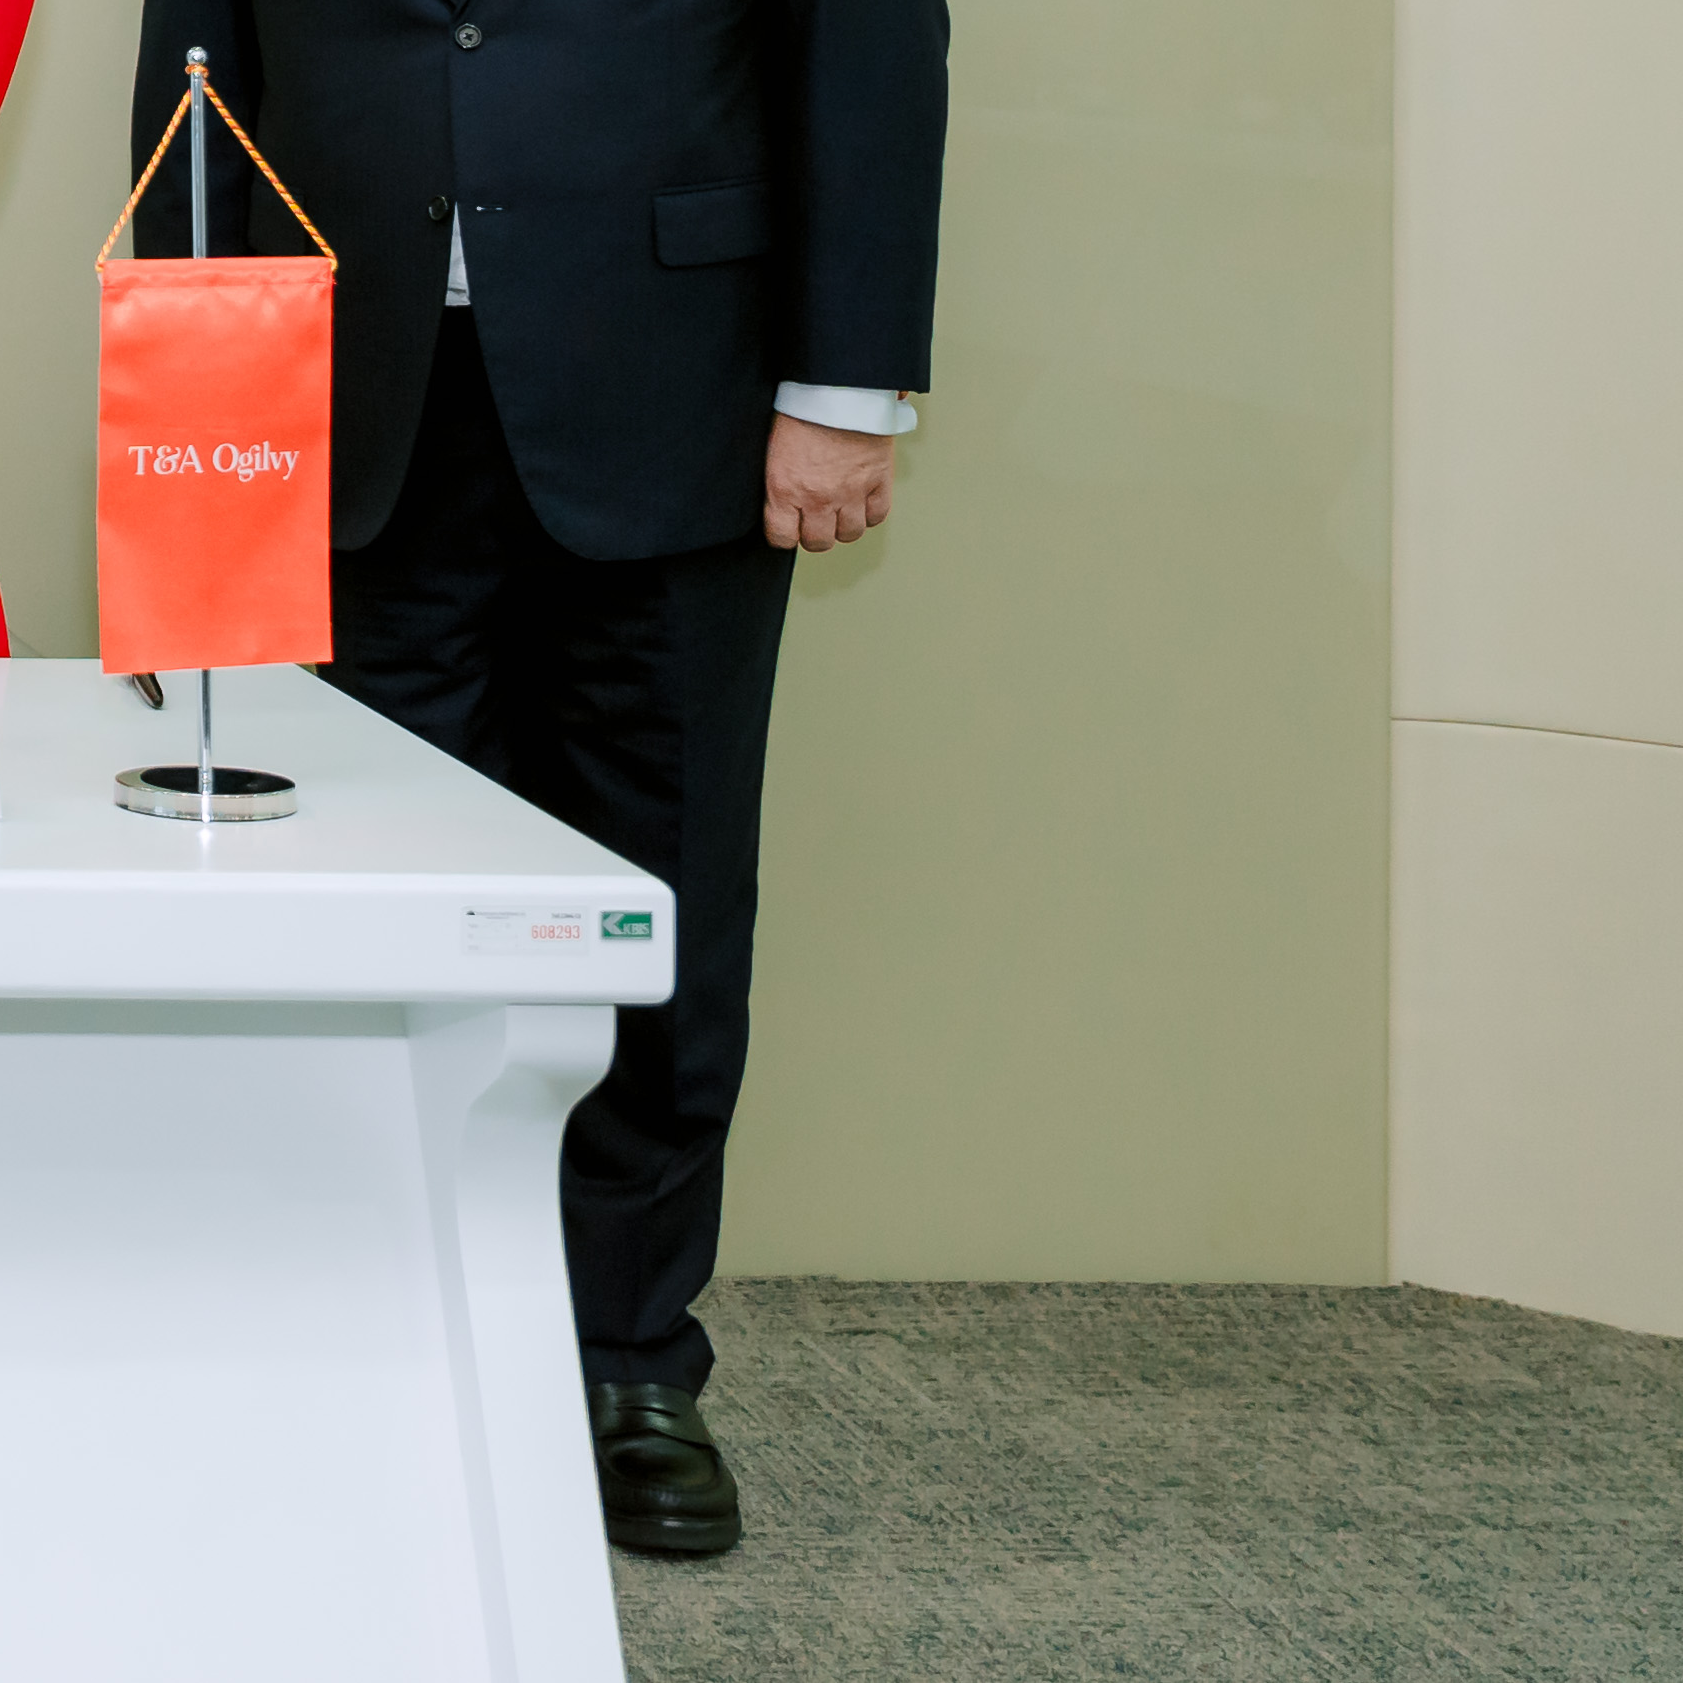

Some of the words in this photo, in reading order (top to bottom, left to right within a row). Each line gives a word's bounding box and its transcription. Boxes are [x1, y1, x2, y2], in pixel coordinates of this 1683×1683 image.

[128, 444, 204, 475] T&A
[212, 440, 300, 483] Ogilvy
[530, 924, 581, 939] 608293
